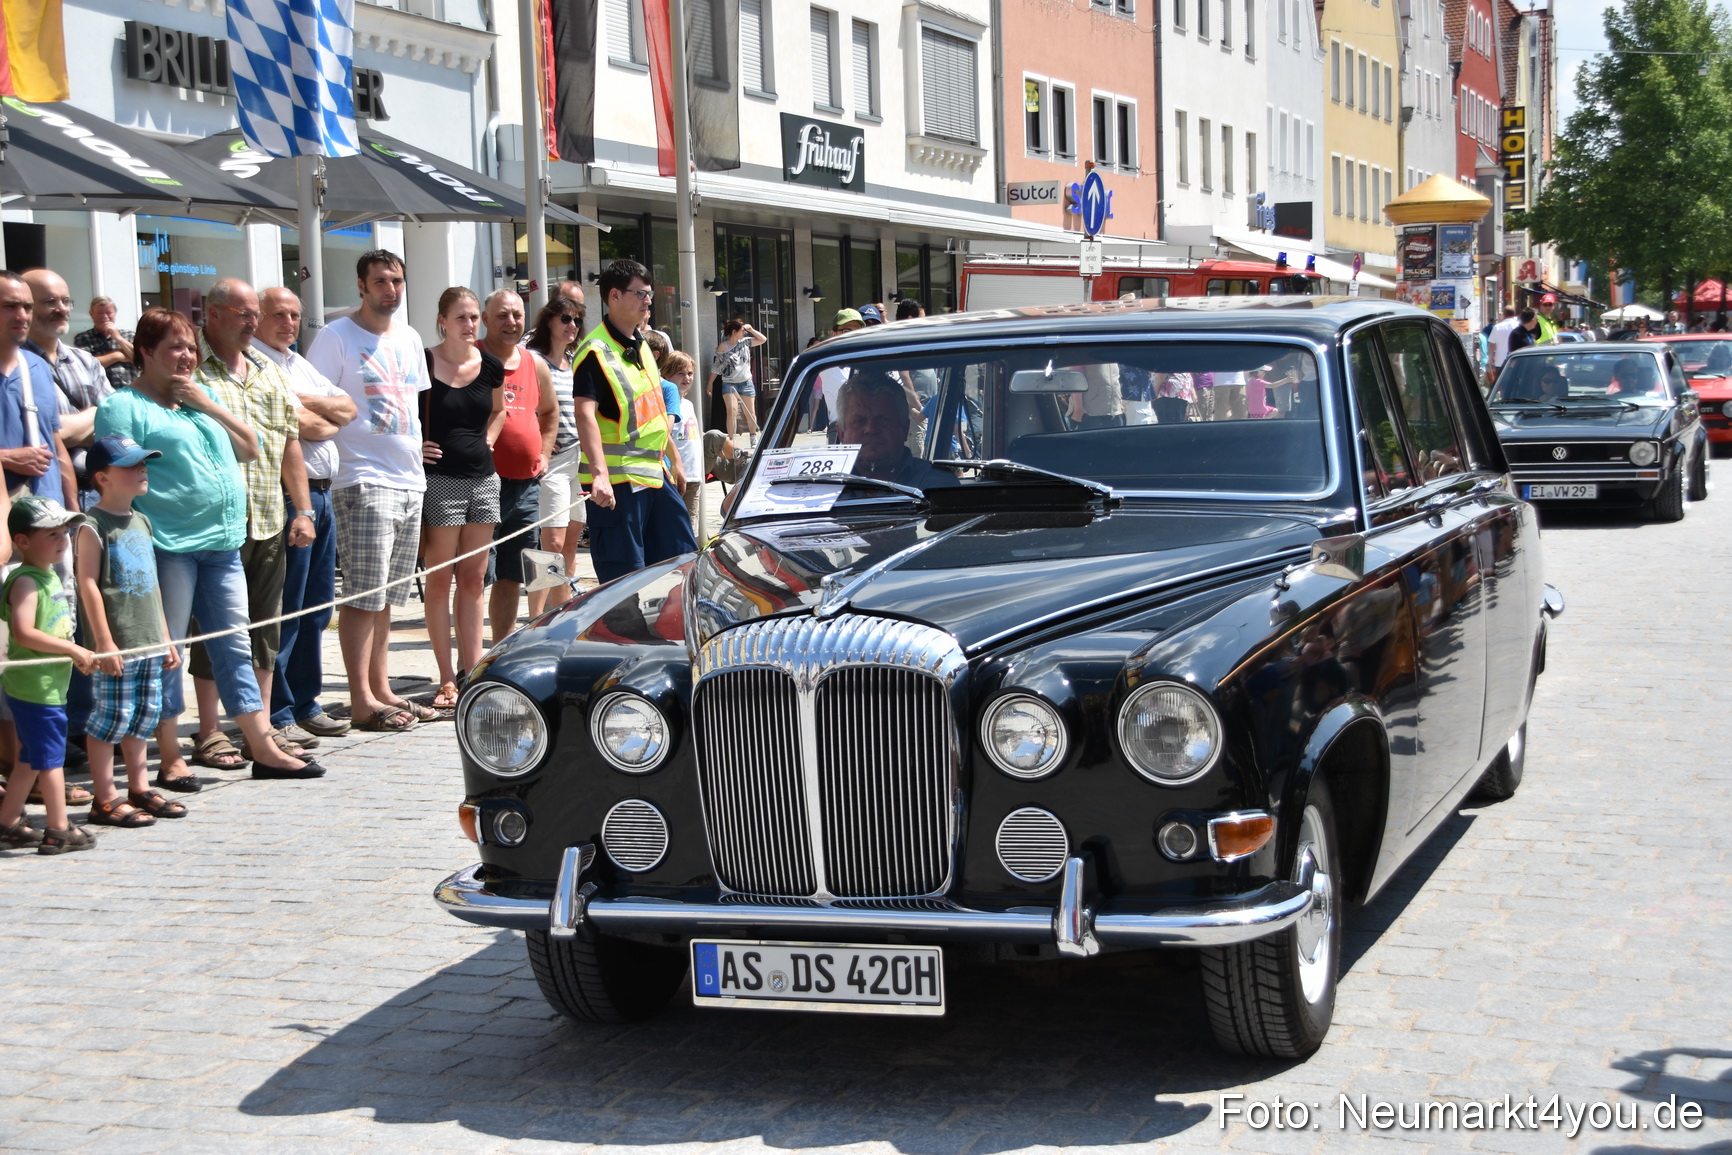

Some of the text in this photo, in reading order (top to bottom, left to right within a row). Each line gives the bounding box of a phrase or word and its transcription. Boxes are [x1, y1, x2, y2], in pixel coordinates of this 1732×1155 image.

[125, 20, 238, 98] BRILL
[788, 124, 864, 184] frühauf
[1502, 108, 1525, 229] HOTE
[158, 262, 217, 276] die günstige Linie
[799, 459, 835, 476] 288
[1530, 486, 1545, 498] EI
[1554, 486, 1569, 498] VW
[1572, 485, 1587, 497] 29
[704, 974, 713, 985] D
[721, 951, 938, 997] AS DS 420H
